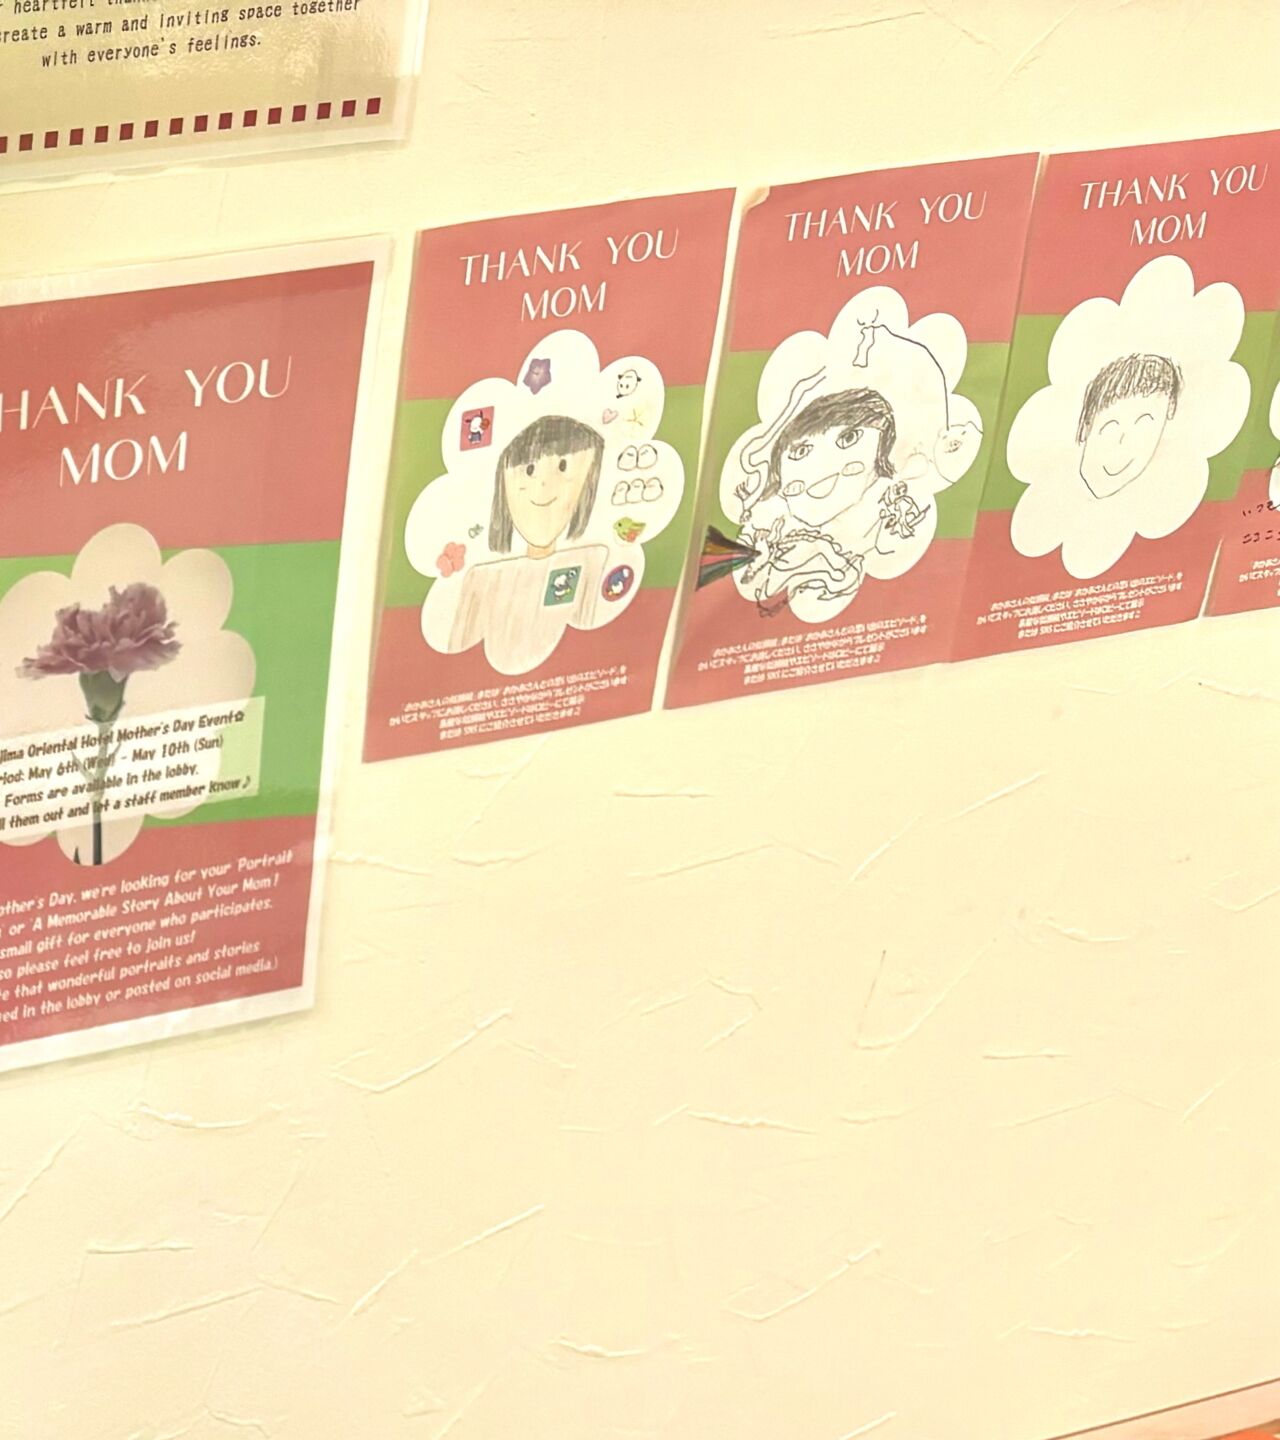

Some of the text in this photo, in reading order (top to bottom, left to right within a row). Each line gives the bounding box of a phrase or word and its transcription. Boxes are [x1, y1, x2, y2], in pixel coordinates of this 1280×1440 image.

[58, 25, 66, 38] a
[76, 20, 112, 37] warm
[122, 15, 148, 32] and
[160, 9, 229, 28] inviting
[239, 4, 282, 21] space
[293, 0, 361, 16] together
[41, 34, 261, 68] with everyone's feelings.
[1079, 162, 1269, 211] THANK YOU
[783, 190, 988, 242] THANK YOU
[1128, 211, 1208, 249] MOM
[459, 227, 679, 286] THANK YOU
[836, 240, 920, 279] MOM
[520, 280, 607, 323] MOM
[185, 355, 292, 407] YOU
[59, 431, 188, 487] MOM
[28, 737, 78, 757] Oriental
[81, 731, 113, 748] Hotel
[117, 722, 170, 742] Mother's
[173, 718, 195, 733] Day
[199, 711, 233, 728] Event
[28, 767, 52, 780] May
[57, 760, 79, 776] 6th
[132, 749, 156, 762] May
[162, 743, 190, 758] 10th
[194, 734, 224, 753] (Sun)
[5, 763, 199, 807] Forms are available in the lobby.
[9, 813, 39, 828] them
[43, 809, 64, 822] out
[67, 802, 89, 818] and
[124, 790, 157, 808] staff
[160, 783, 206, 802] member
[209, 778, 241, 793] know
[81, 883, 116, 901] we're
[121, 874, 169, 893] looking
[174, 868, 197, 883] for
[201, 864, 232, 879] your
[8, 924, 26, 936] or
[47, 903, 117, 928] Memorable
[122, 897, 159, 914] Story
[164, 887, 202, 907] About
[207, 883, 239, 898] Your
[0, 940, 32, 960] small
[36, 936, 62, 954] gift
[67, 931, 90, 947] for
[93, 918, 156, 941] everyone
[160, 912, 186, 928] who
[17, 958, 59, 979] please
[64, 950, 88, 968] feel
[93, 945, 122, 962] free
[127, 941, 140, 955] to
[145, 937, 172, 954] join
[175, 930, 196, 946] us!
[14, 981, 43, 998] that
[47, 966, 115, 990] wonderful
[119, 955, 182, 979] portraits
[185, 949, 209, 965] and
[213, 941, 261, 960] stories
[22, 1004, 36, 1019] in
[40, 999, 63, 1015] the
[66, 992, 101, 1011] lobby
[105, 989, 121, 1002] or
[125, 977, 171, 999] posted
[174, 975, 191, 988] on
[195, 965, 231, 985] social
